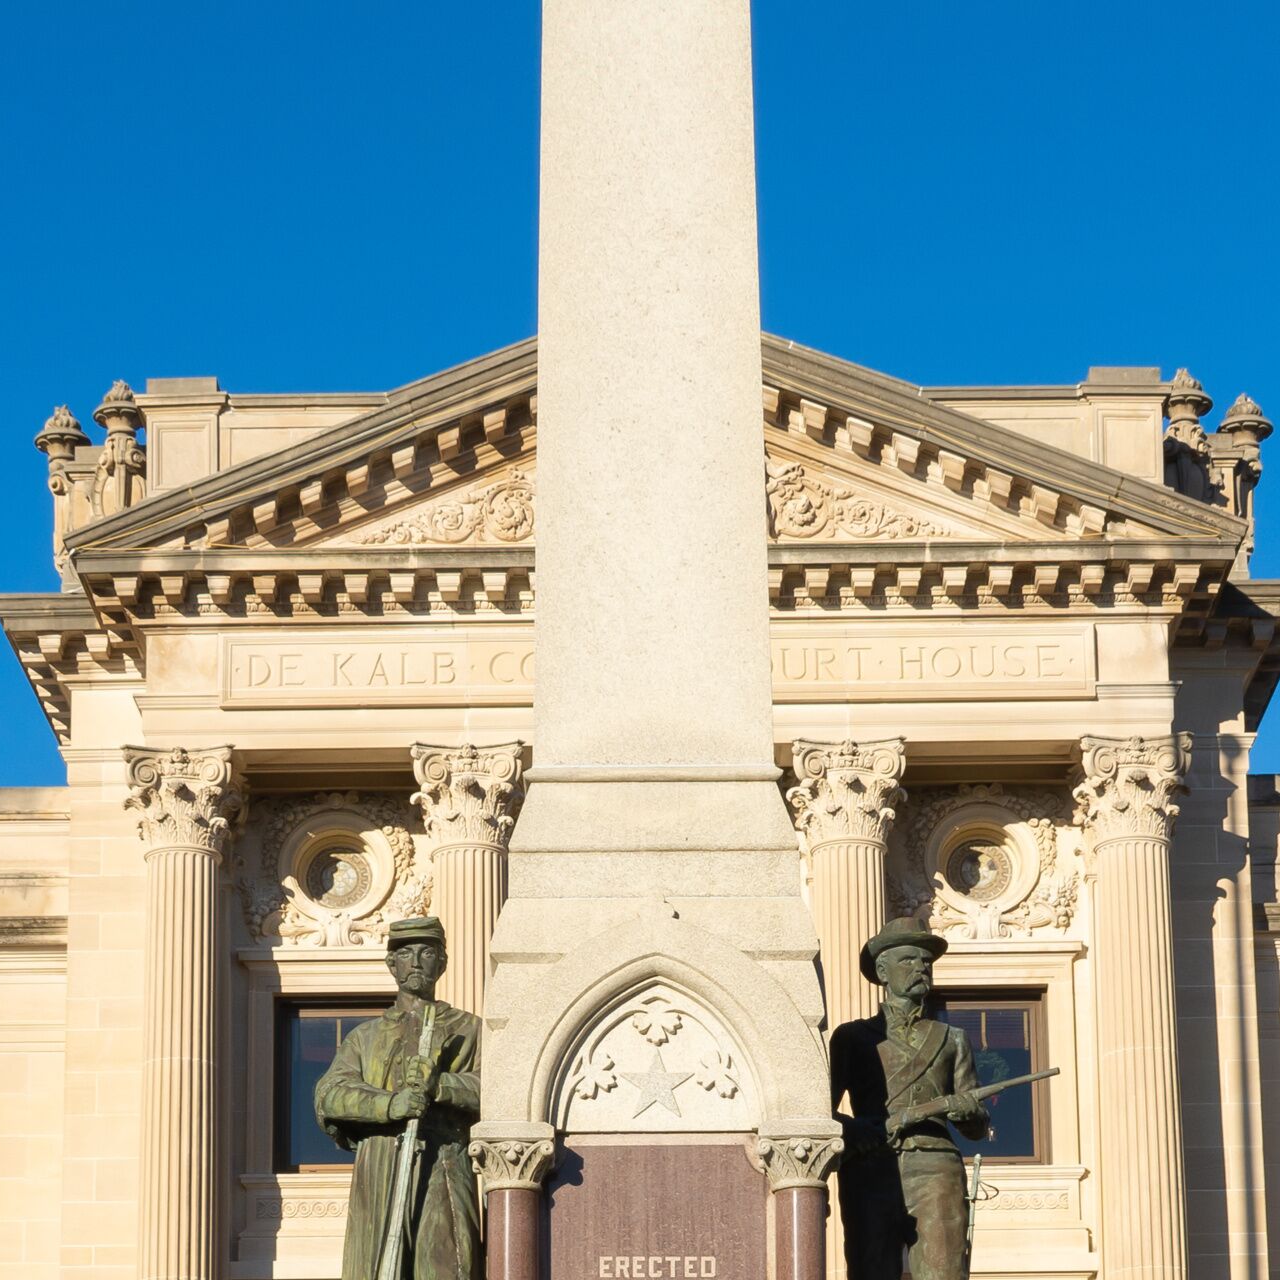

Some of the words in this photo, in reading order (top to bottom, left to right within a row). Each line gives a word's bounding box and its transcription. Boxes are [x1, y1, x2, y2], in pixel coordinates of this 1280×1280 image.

[248, 654, 305, 687] DE
[331, 652, 456, 686] KALB
[771, 647, 872, 680] URT
[899, 645, 1063, 680] HOUSE
[599, 1256, 717, 1278] ERECTED
